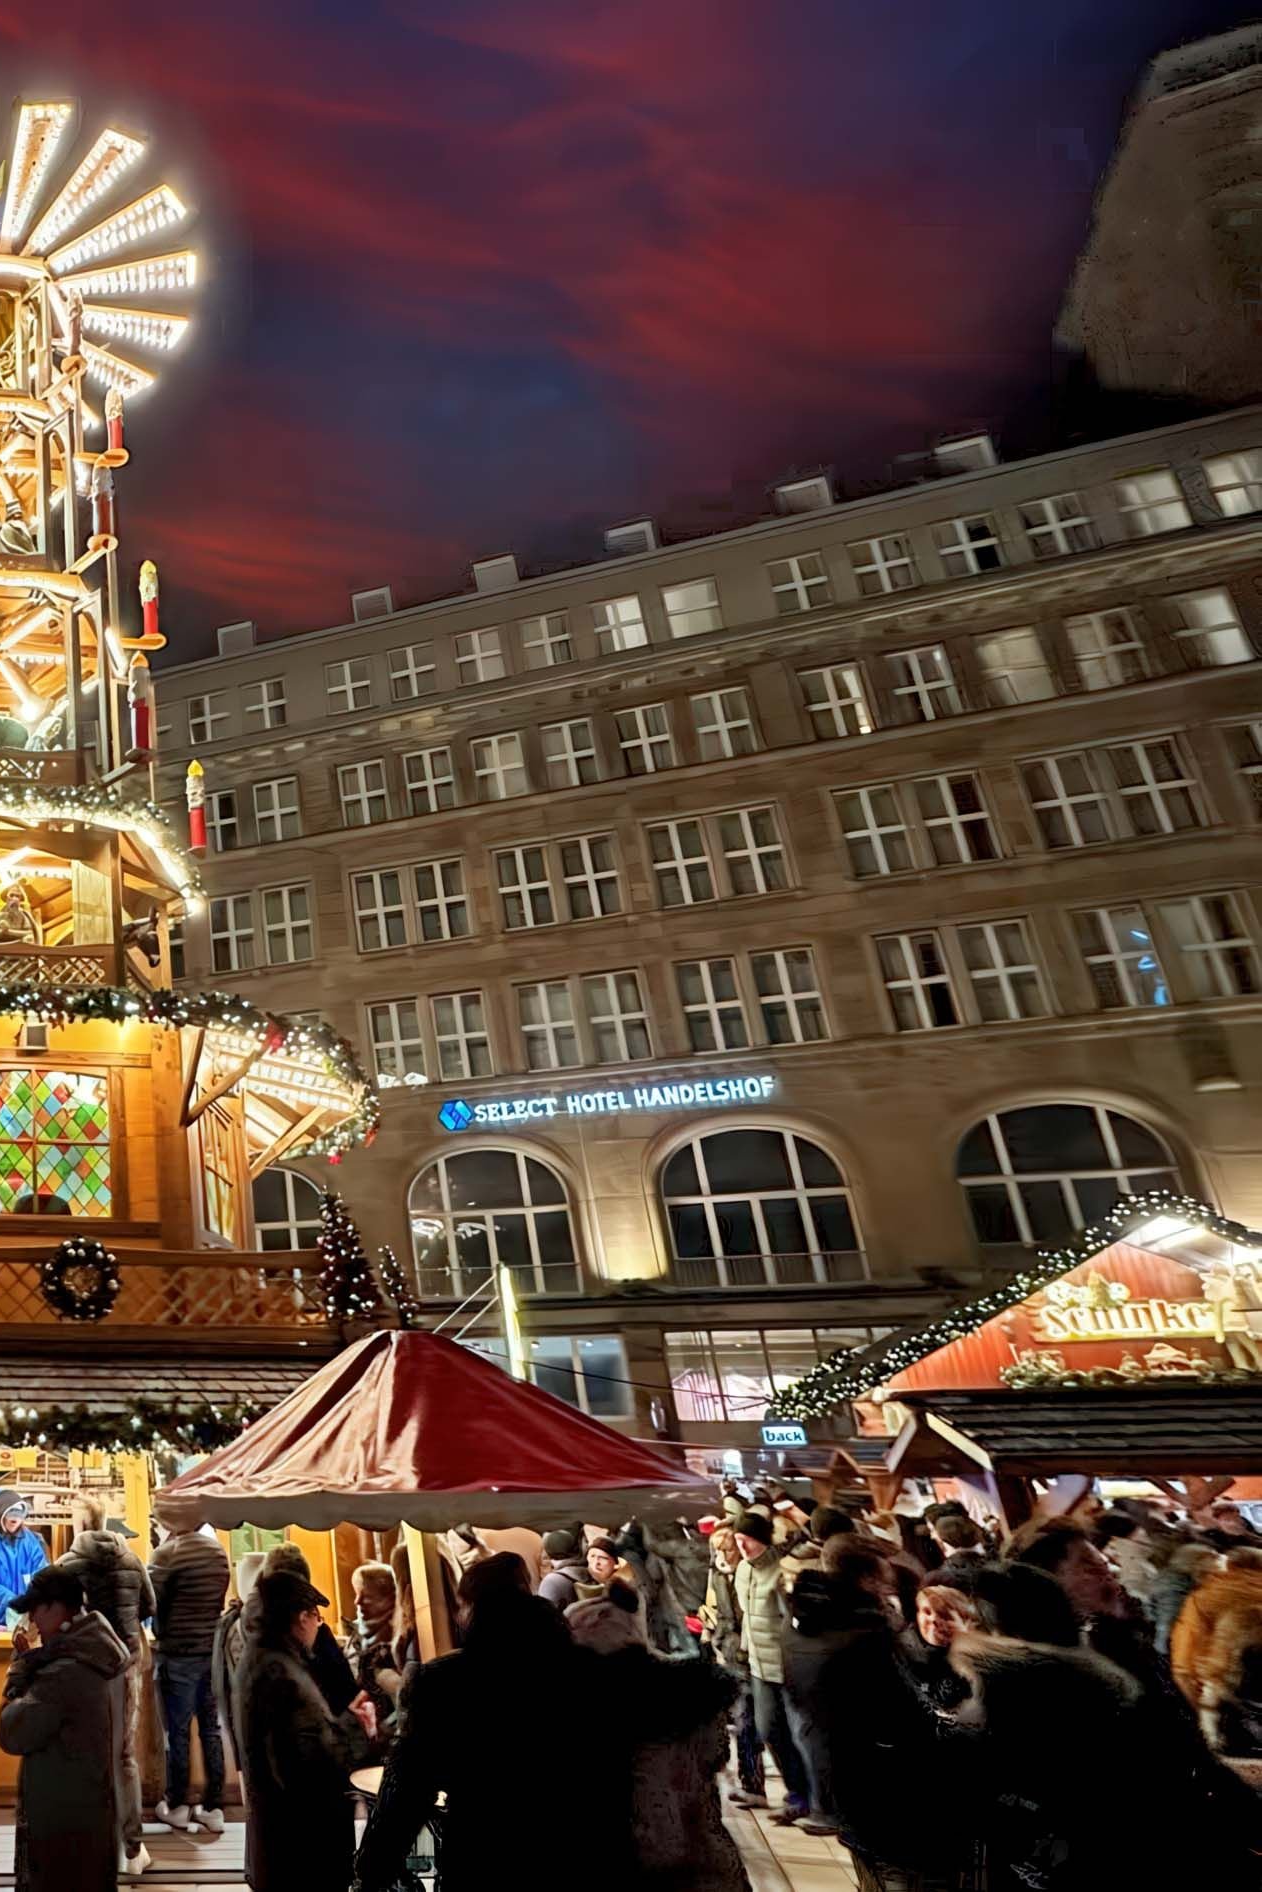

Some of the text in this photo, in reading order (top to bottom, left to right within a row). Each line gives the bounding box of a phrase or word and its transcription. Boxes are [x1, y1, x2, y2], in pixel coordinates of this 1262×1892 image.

[474, 1075, 775, 1122] SELECT HOTEL HANDELSHOF
[765, 1430, 803, 1442] back
